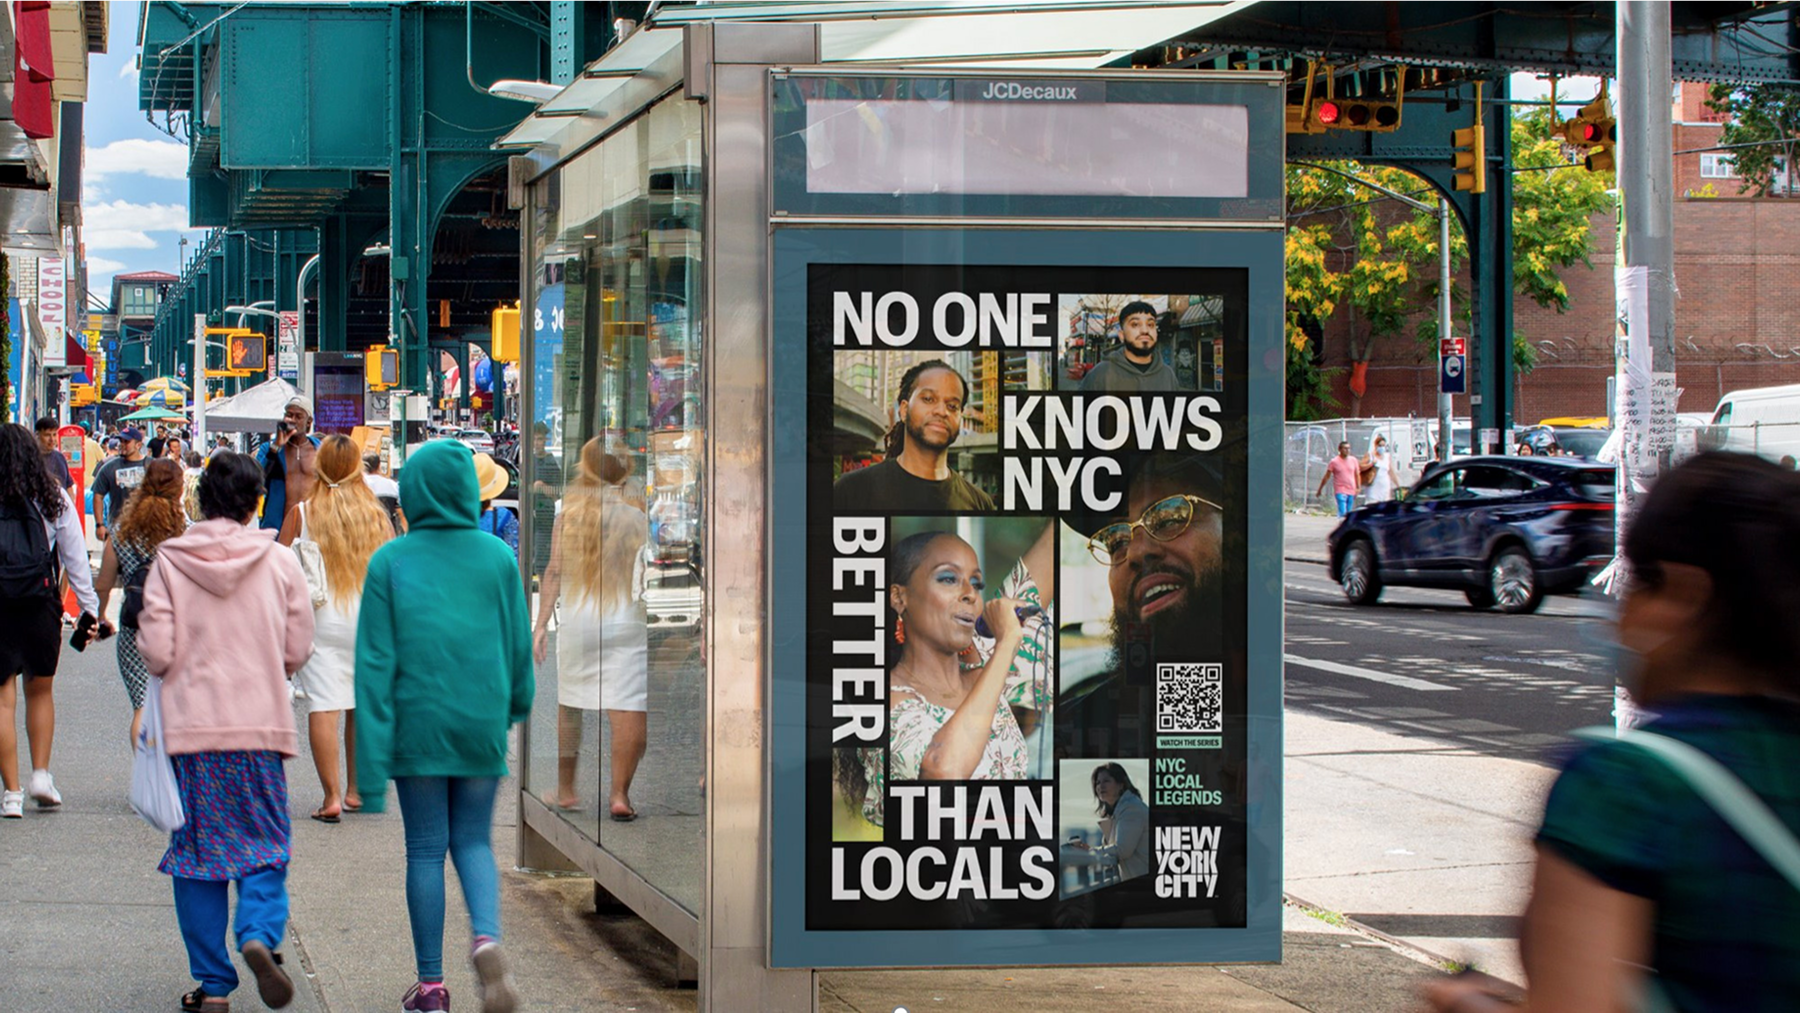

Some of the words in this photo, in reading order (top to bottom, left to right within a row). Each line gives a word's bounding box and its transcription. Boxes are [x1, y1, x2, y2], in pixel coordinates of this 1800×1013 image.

[982, 82, 1077, 100] JCDecaux
[833, 291, 919, 347] NO
[932, 291, 1052, 347] ONE
[108, 341, 117, 384] BLUE
[1003, 395, 1223, 451] KNOWS
[1003, 456, 1123, 512] NYC
[832, 516, 886, 743] BETTER
[1155, 758, 1186, 773] NYC
[1155, 774, 1204, 789] LOCAL
[889, 785, 1053, 841] THAN
[1155, 790, 1222, 805] LEGENDS
[1155, 826, 1222, 850] NEW
[831, 845, 1055, 901] LOCALS
[1155, 850, 1218, 874] YORK
[1155, 873, 1217, 898] CITY
